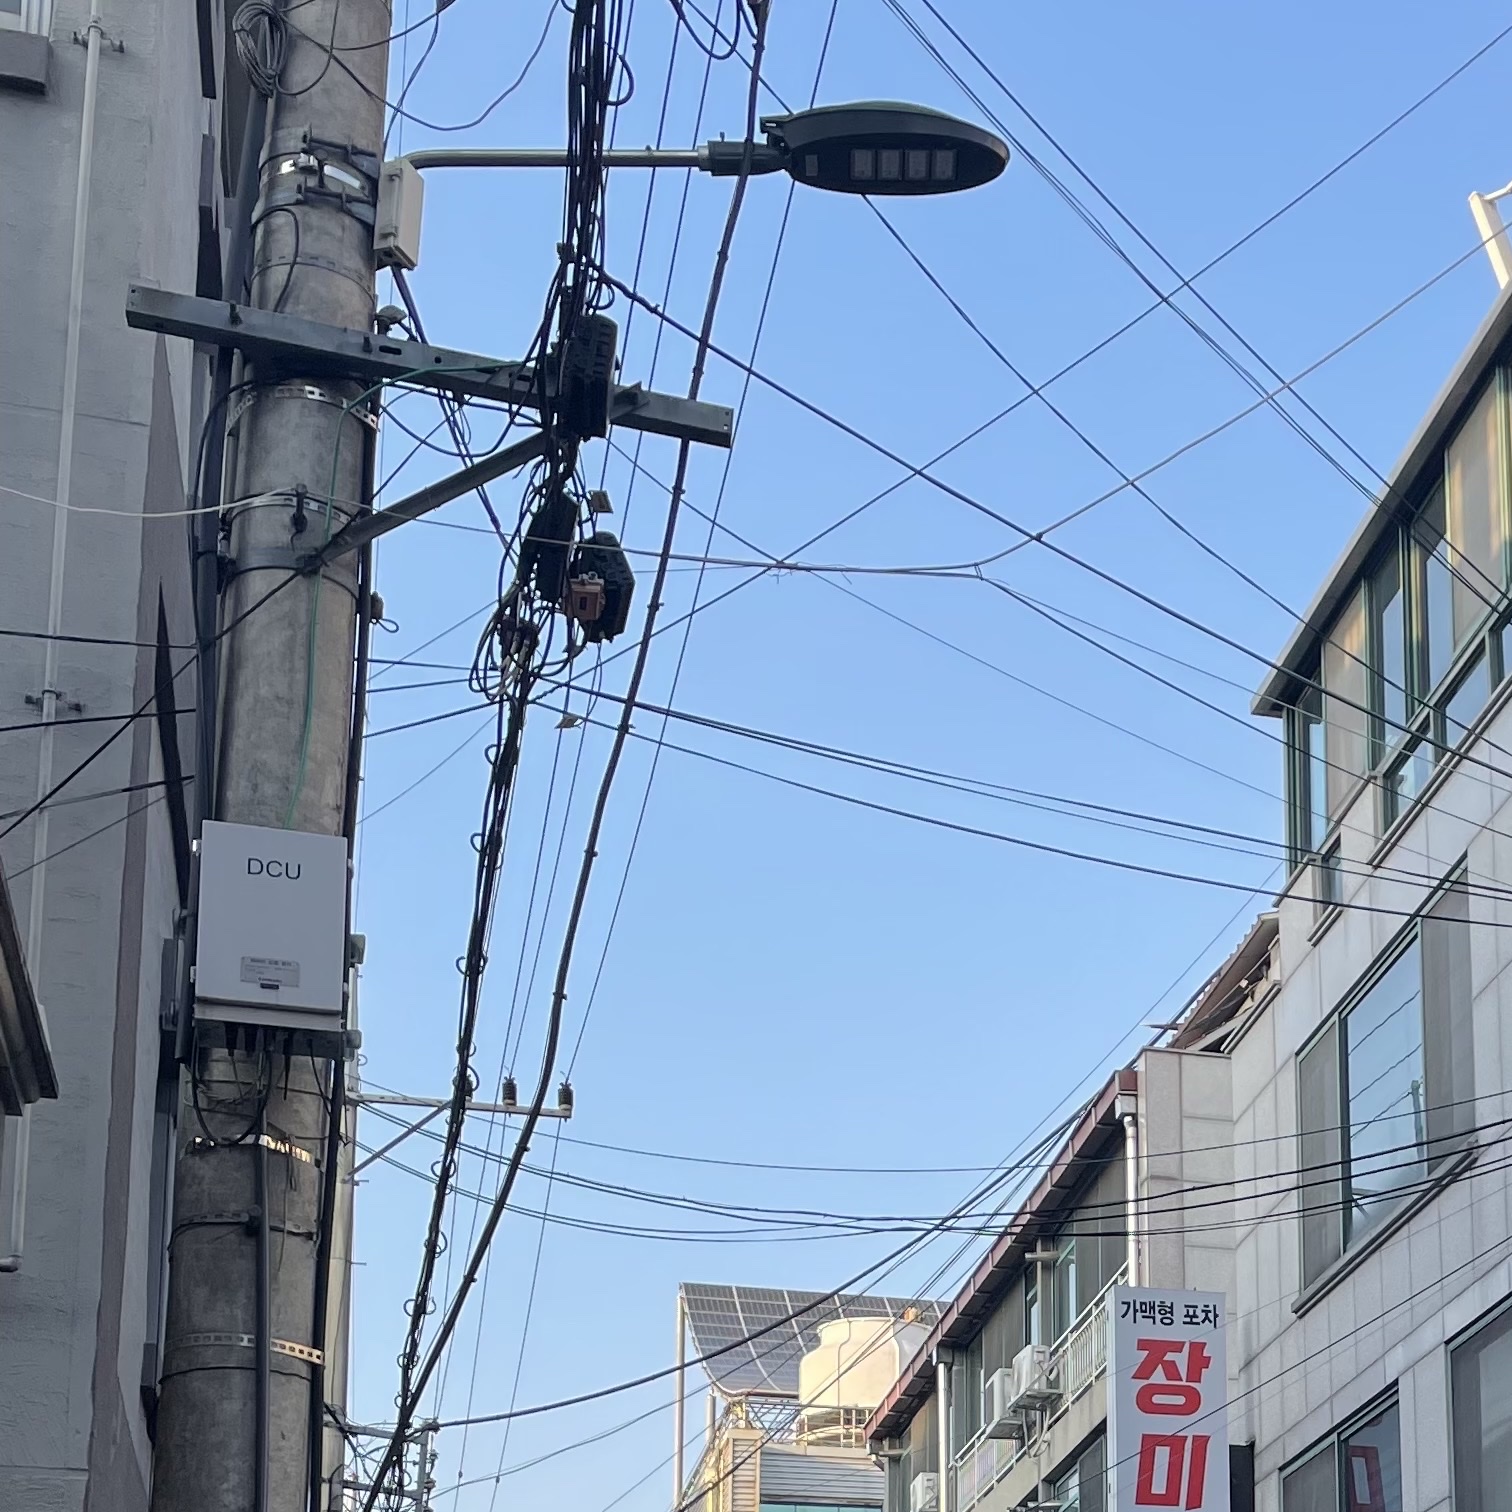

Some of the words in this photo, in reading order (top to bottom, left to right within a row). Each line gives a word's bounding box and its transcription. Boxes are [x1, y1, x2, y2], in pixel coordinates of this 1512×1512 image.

[247, 857, 301, 881] DCU
[1121, 1299, 1174, 1326] 가맥형
[1183, 1304, 1219, 1328] 포차
